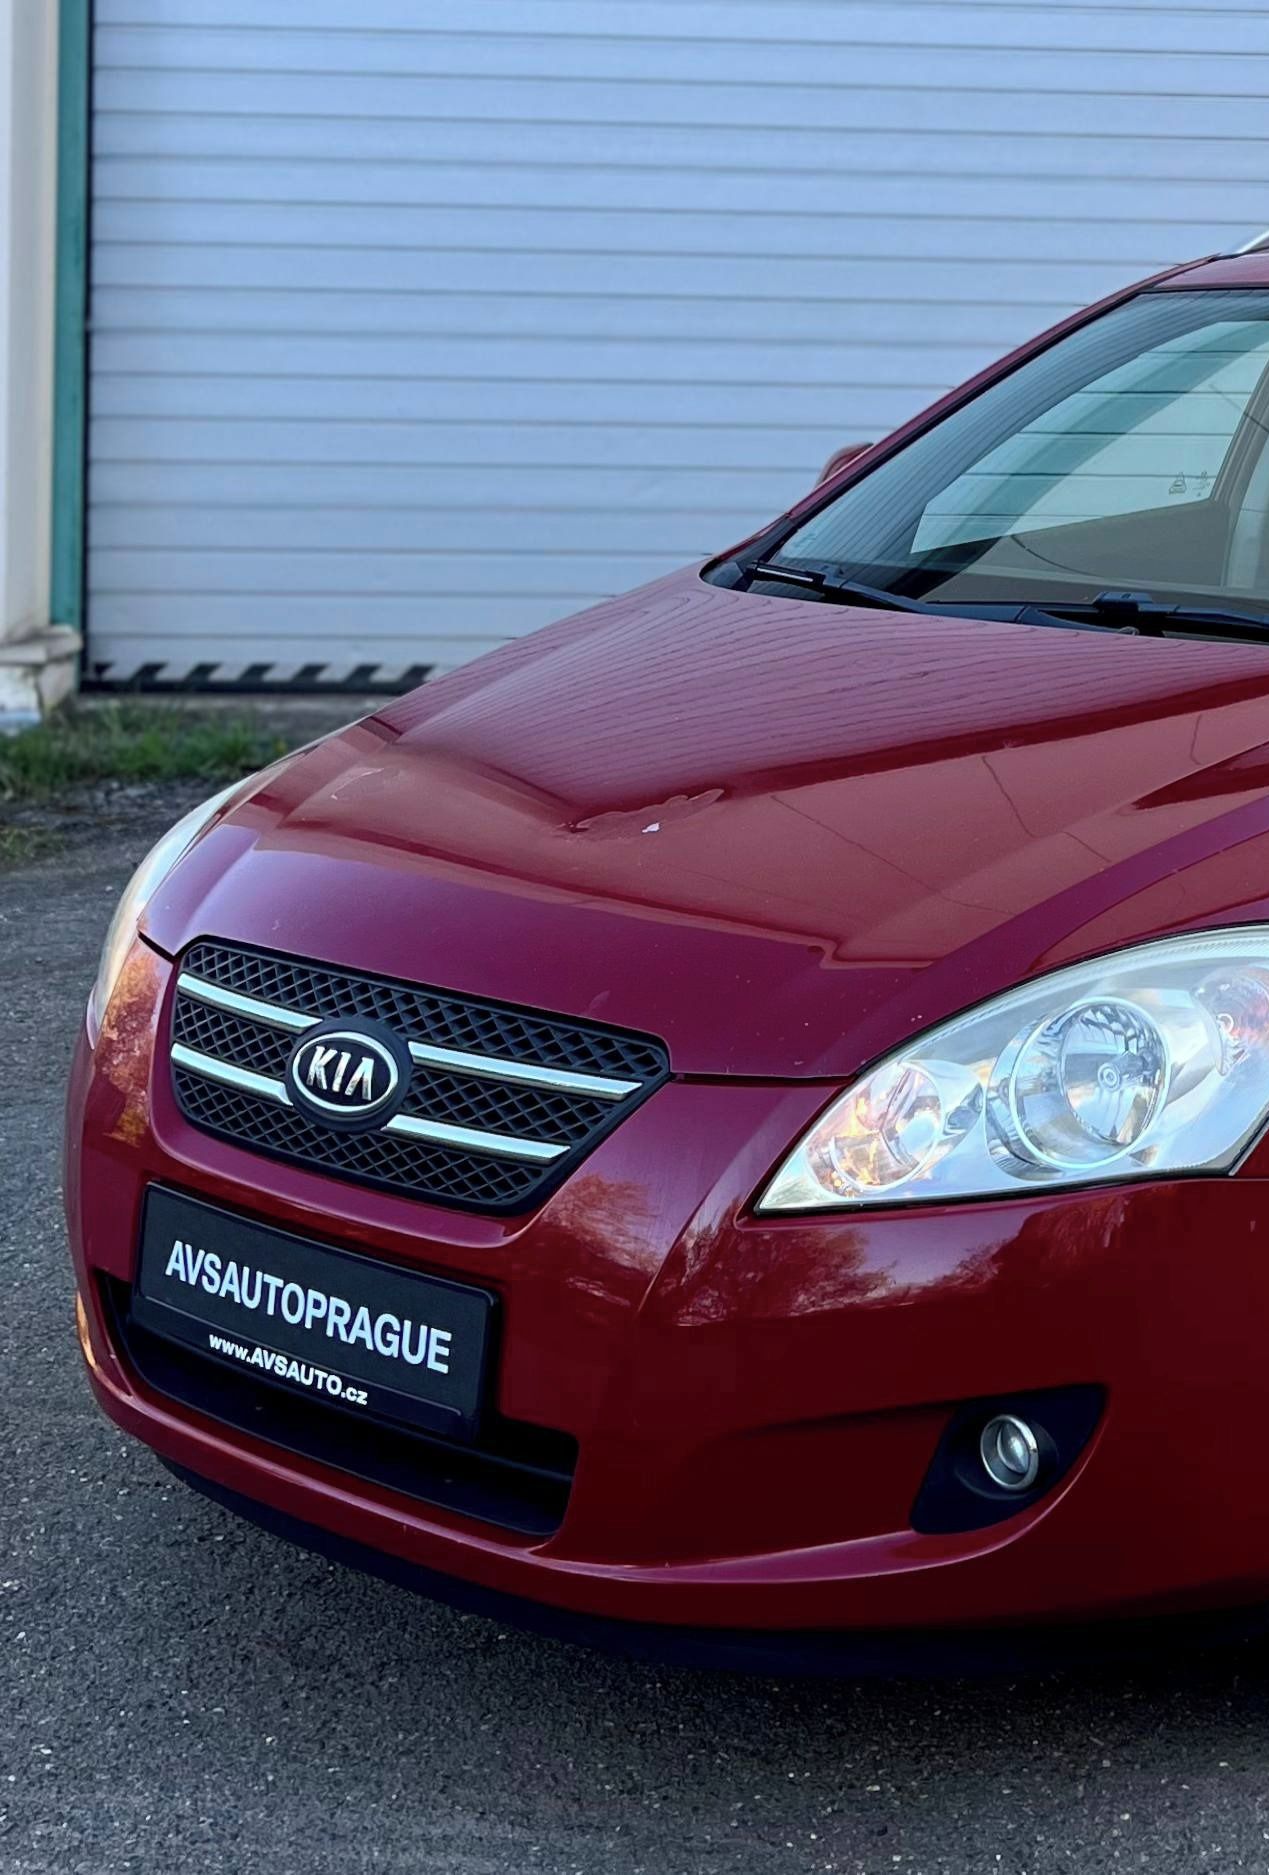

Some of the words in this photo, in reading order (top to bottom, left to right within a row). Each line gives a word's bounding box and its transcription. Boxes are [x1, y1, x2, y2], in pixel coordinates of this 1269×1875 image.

[306, 1046, 374, 1100] KIA
[165, 1240, 451, 1374] AVSAUTOPRAGUE
[209, 1334, 368, 1405] www.AVSAUTO.cz
